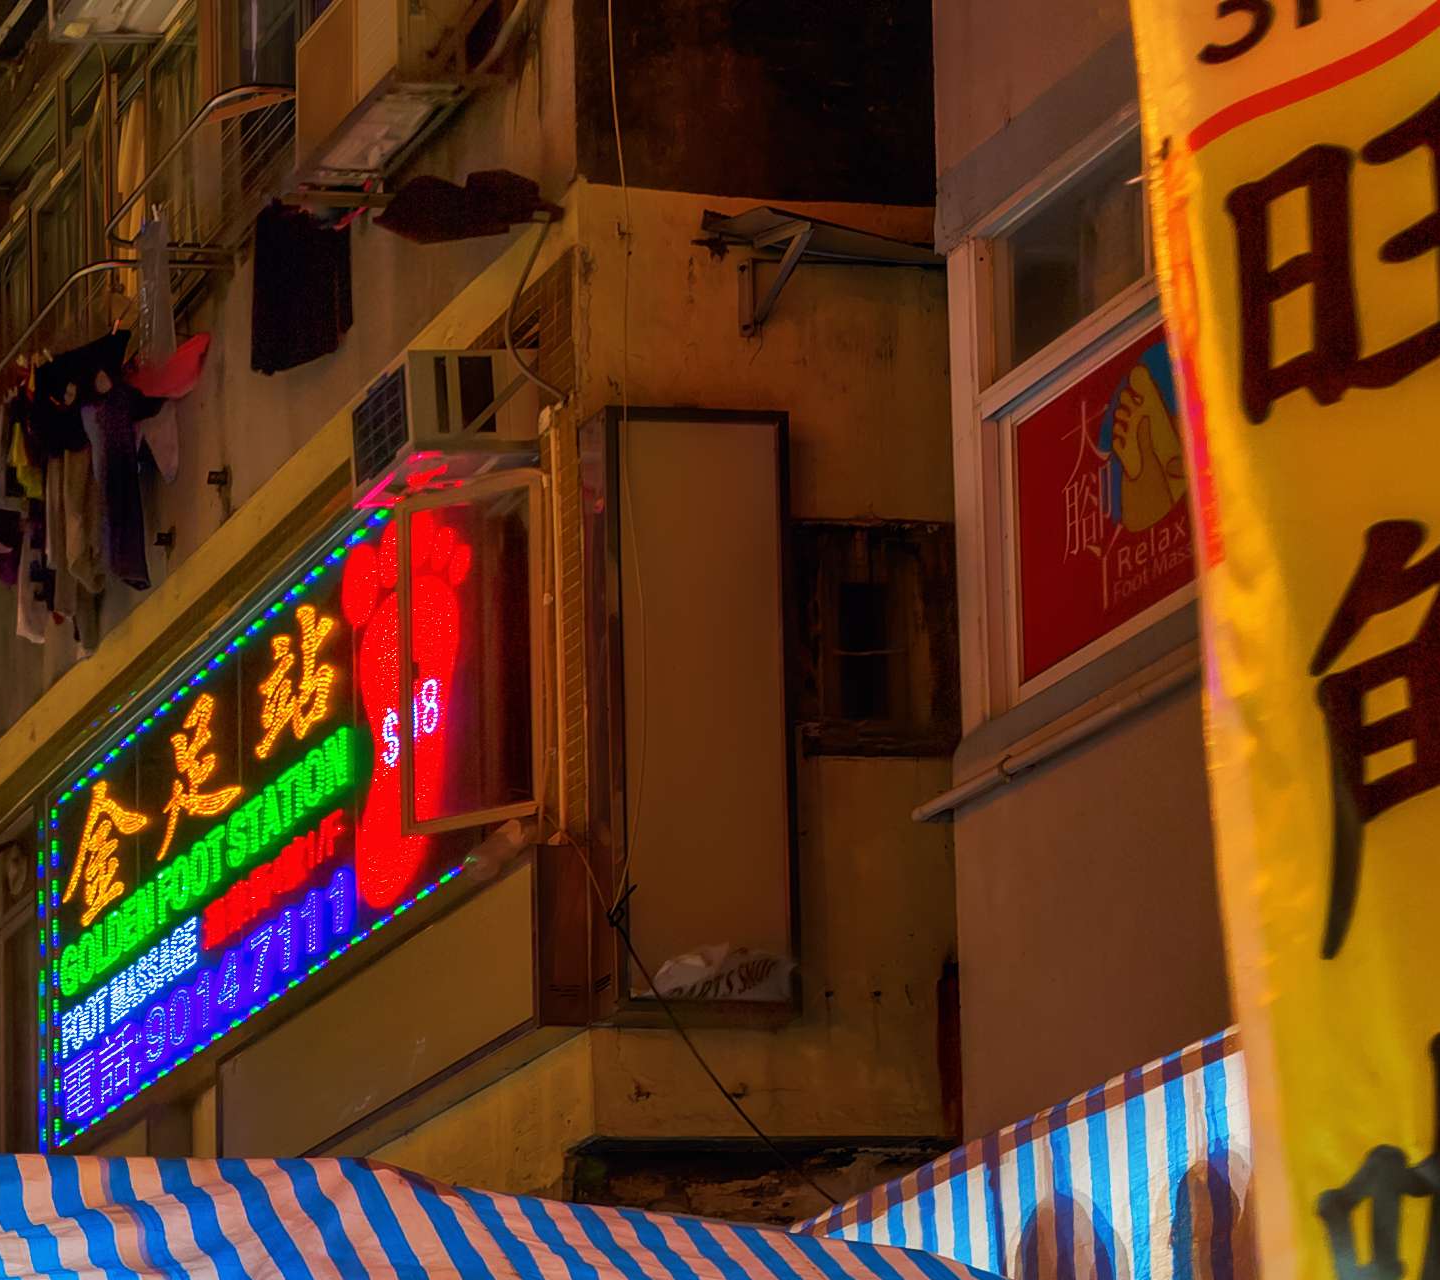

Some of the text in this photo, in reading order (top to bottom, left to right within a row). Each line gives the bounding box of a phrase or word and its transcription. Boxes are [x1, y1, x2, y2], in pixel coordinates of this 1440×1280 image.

[1113, 561, 1151, 598] Foot
[1119, 523, 1188, 577] Relax
[63, 606, 334, 926] 金足站
[60, 876, 155, 997] GOLDEN
[157, 825, 226, 928] FOOT
[227, 725, 349, 867] STATION
[61, 916, 199, 1058] FOOT MASSAGE
